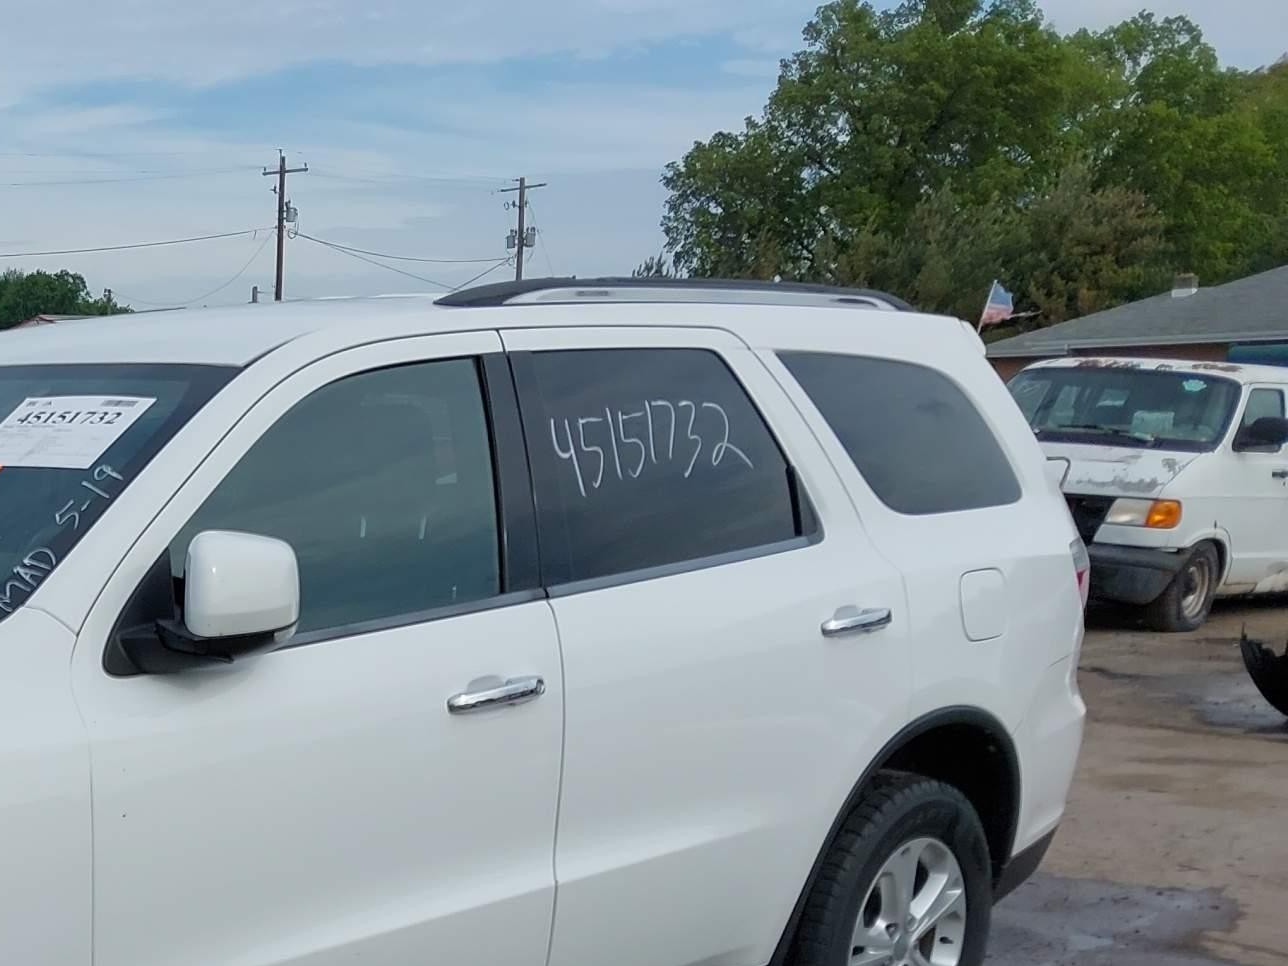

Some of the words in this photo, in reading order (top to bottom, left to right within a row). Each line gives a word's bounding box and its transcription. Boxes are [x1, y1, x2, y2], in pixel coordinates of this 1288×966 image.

[16, 410, 123, 426] 45151732
[549, 399, 754, 497] 45151732
[54, 463, 124, 530] 5-19
